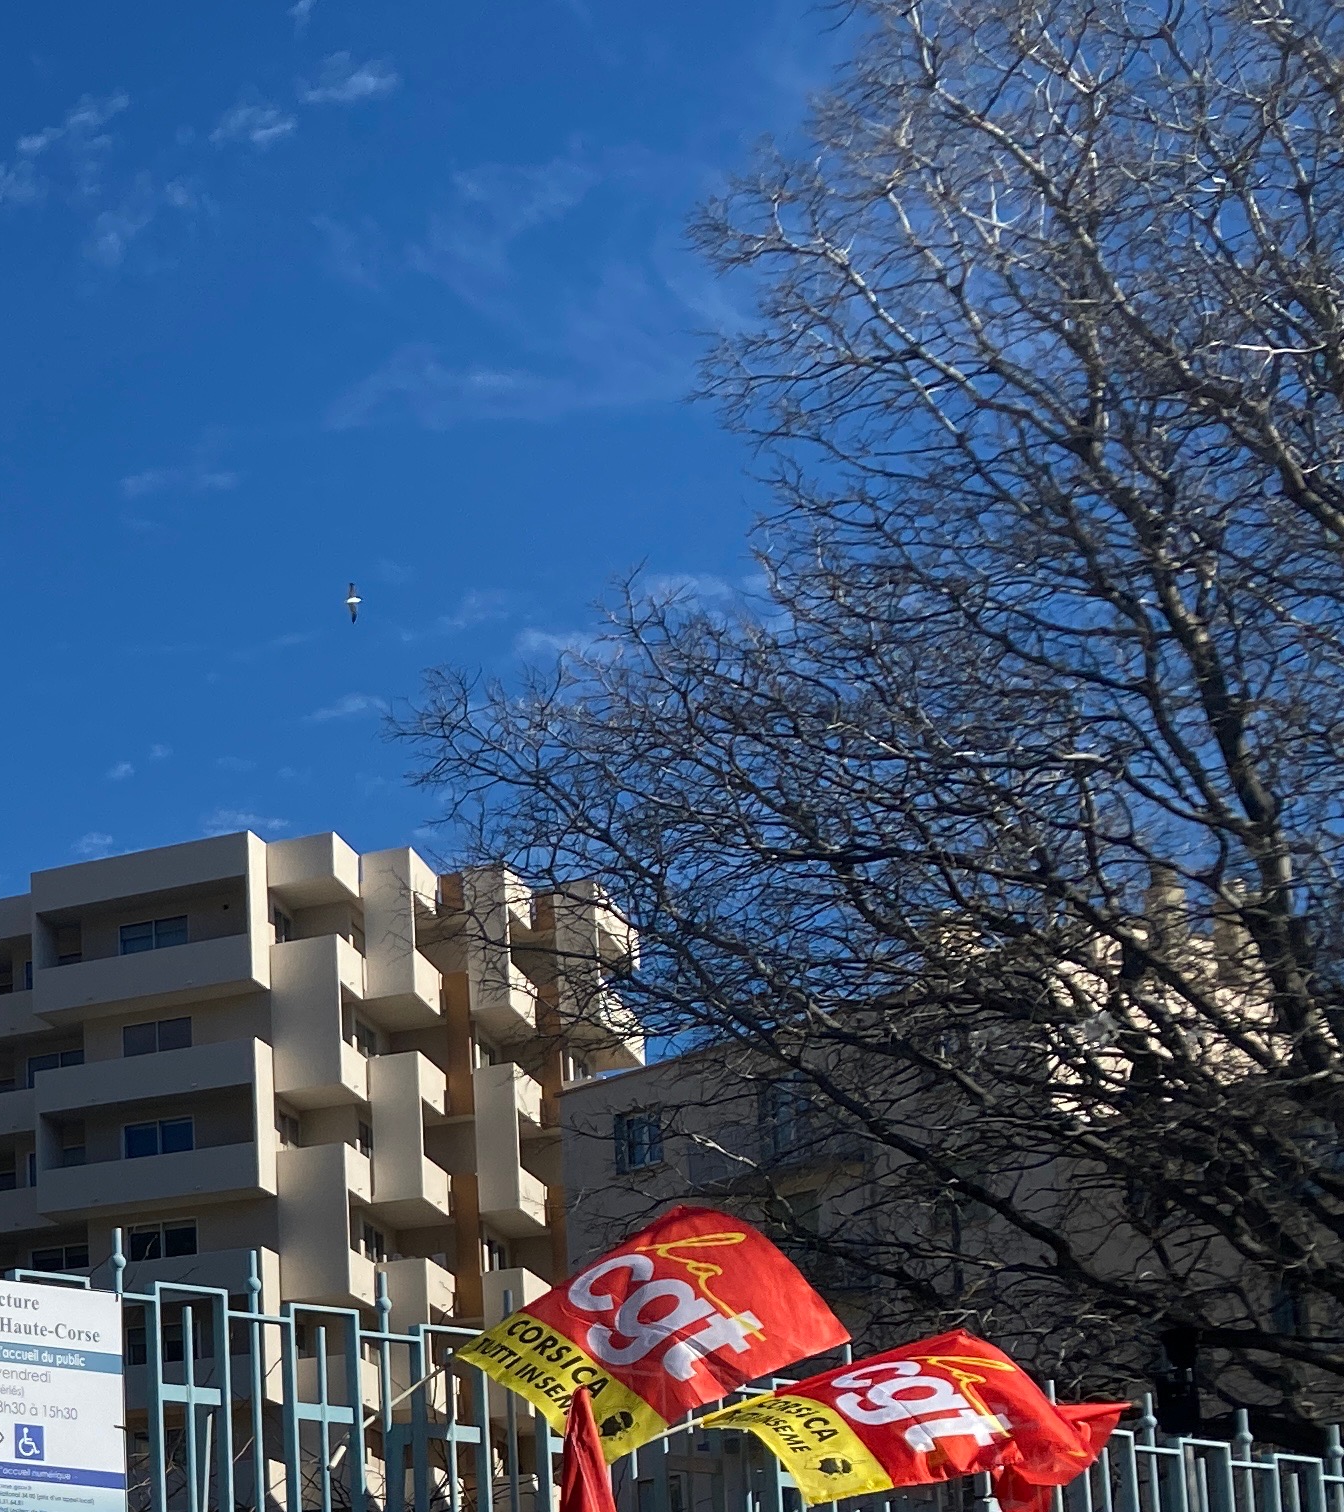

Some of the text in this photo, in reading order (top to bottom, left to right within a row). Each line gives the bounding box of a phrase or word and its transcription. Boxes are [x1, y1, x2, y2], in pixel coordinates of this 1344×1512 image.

[0, 1316, 101, 1343] Haute-Corse
[568, 1253, 765, 1383] cgt
[40, 1351, 54, 1363] du
[55, 1352, 86, 1367] public
[473, 1337, 521, 1370] TUTTI
[507, 1319, 611, 1400] CORSICA
[29, 1403, 39, 1416] à
[42, 1404, 79, 1421] 15h30
[831, 1360, 1013, 1454] cgt
